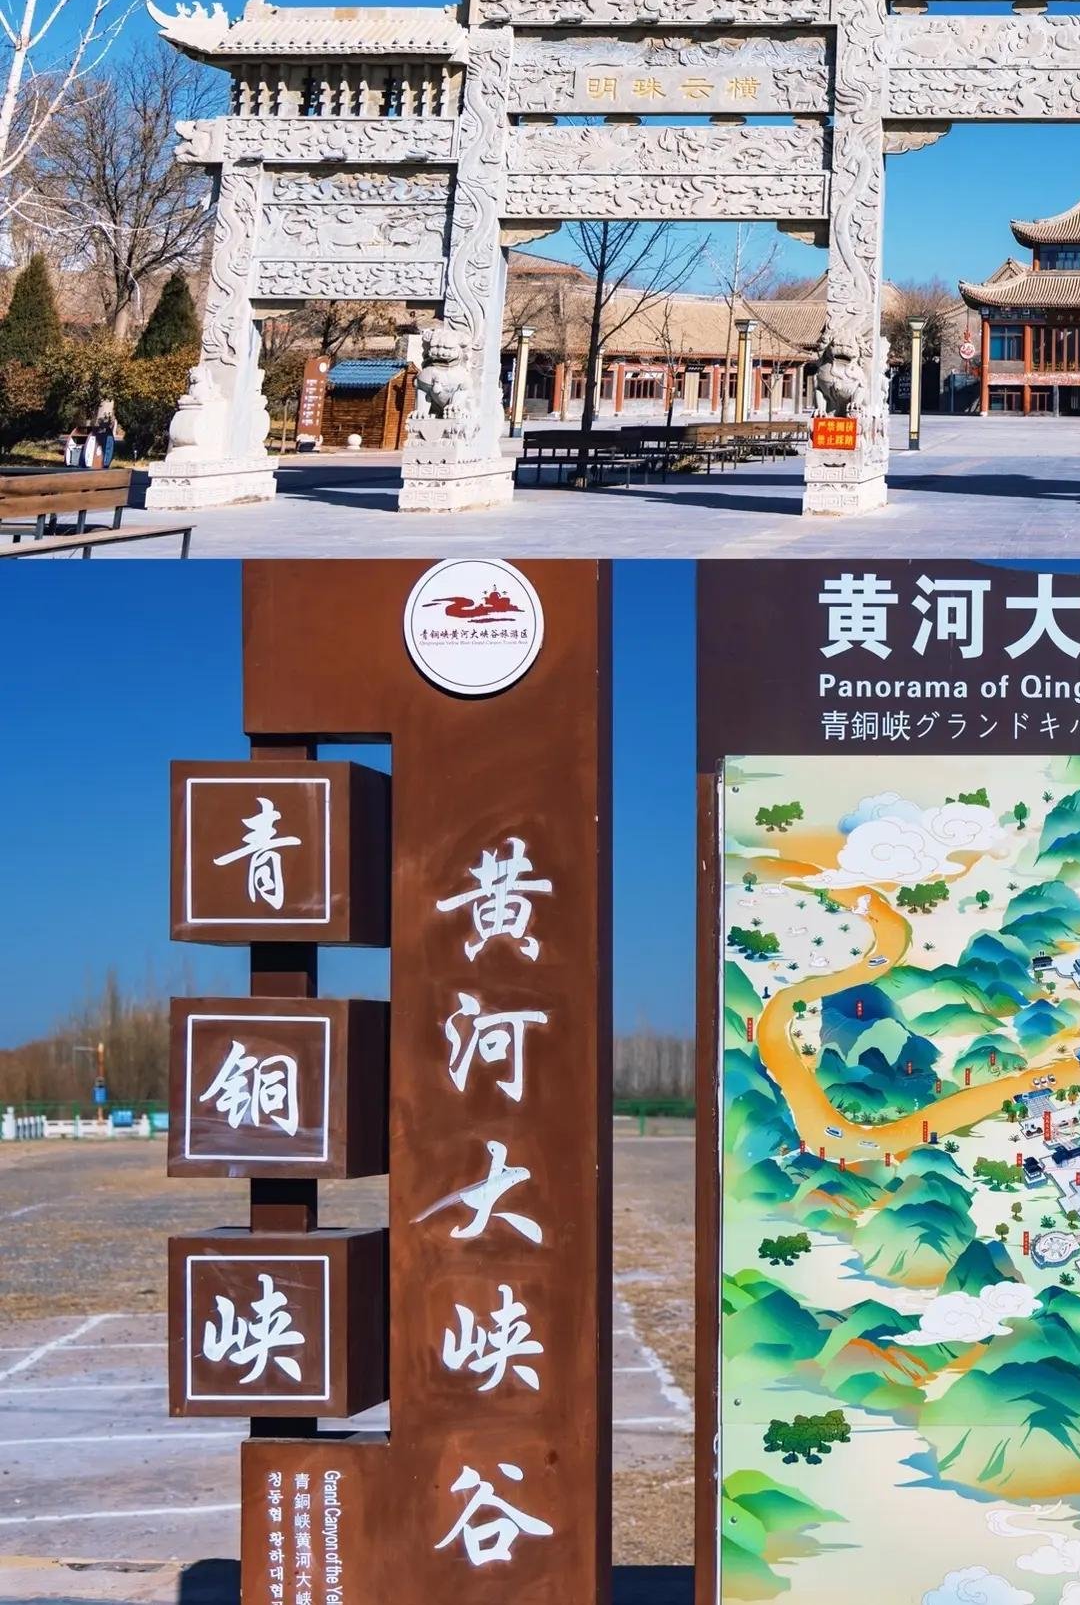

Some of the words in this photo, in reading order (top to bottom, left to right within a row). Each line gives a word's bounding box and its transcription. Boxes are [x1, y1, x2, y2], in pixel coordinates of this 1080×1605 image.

[819, 674, 969, 698] Panorama
[980, 674, 1009, 698] of
[410, 836, 555, 1567] 黄河大峡谷
[324, 1470, 342, 1505] Grand
[321, 1507, 342, 1551] Canyon
[325, 1552, 343, 1564] of
[325, 1564, 343, 1584] the
